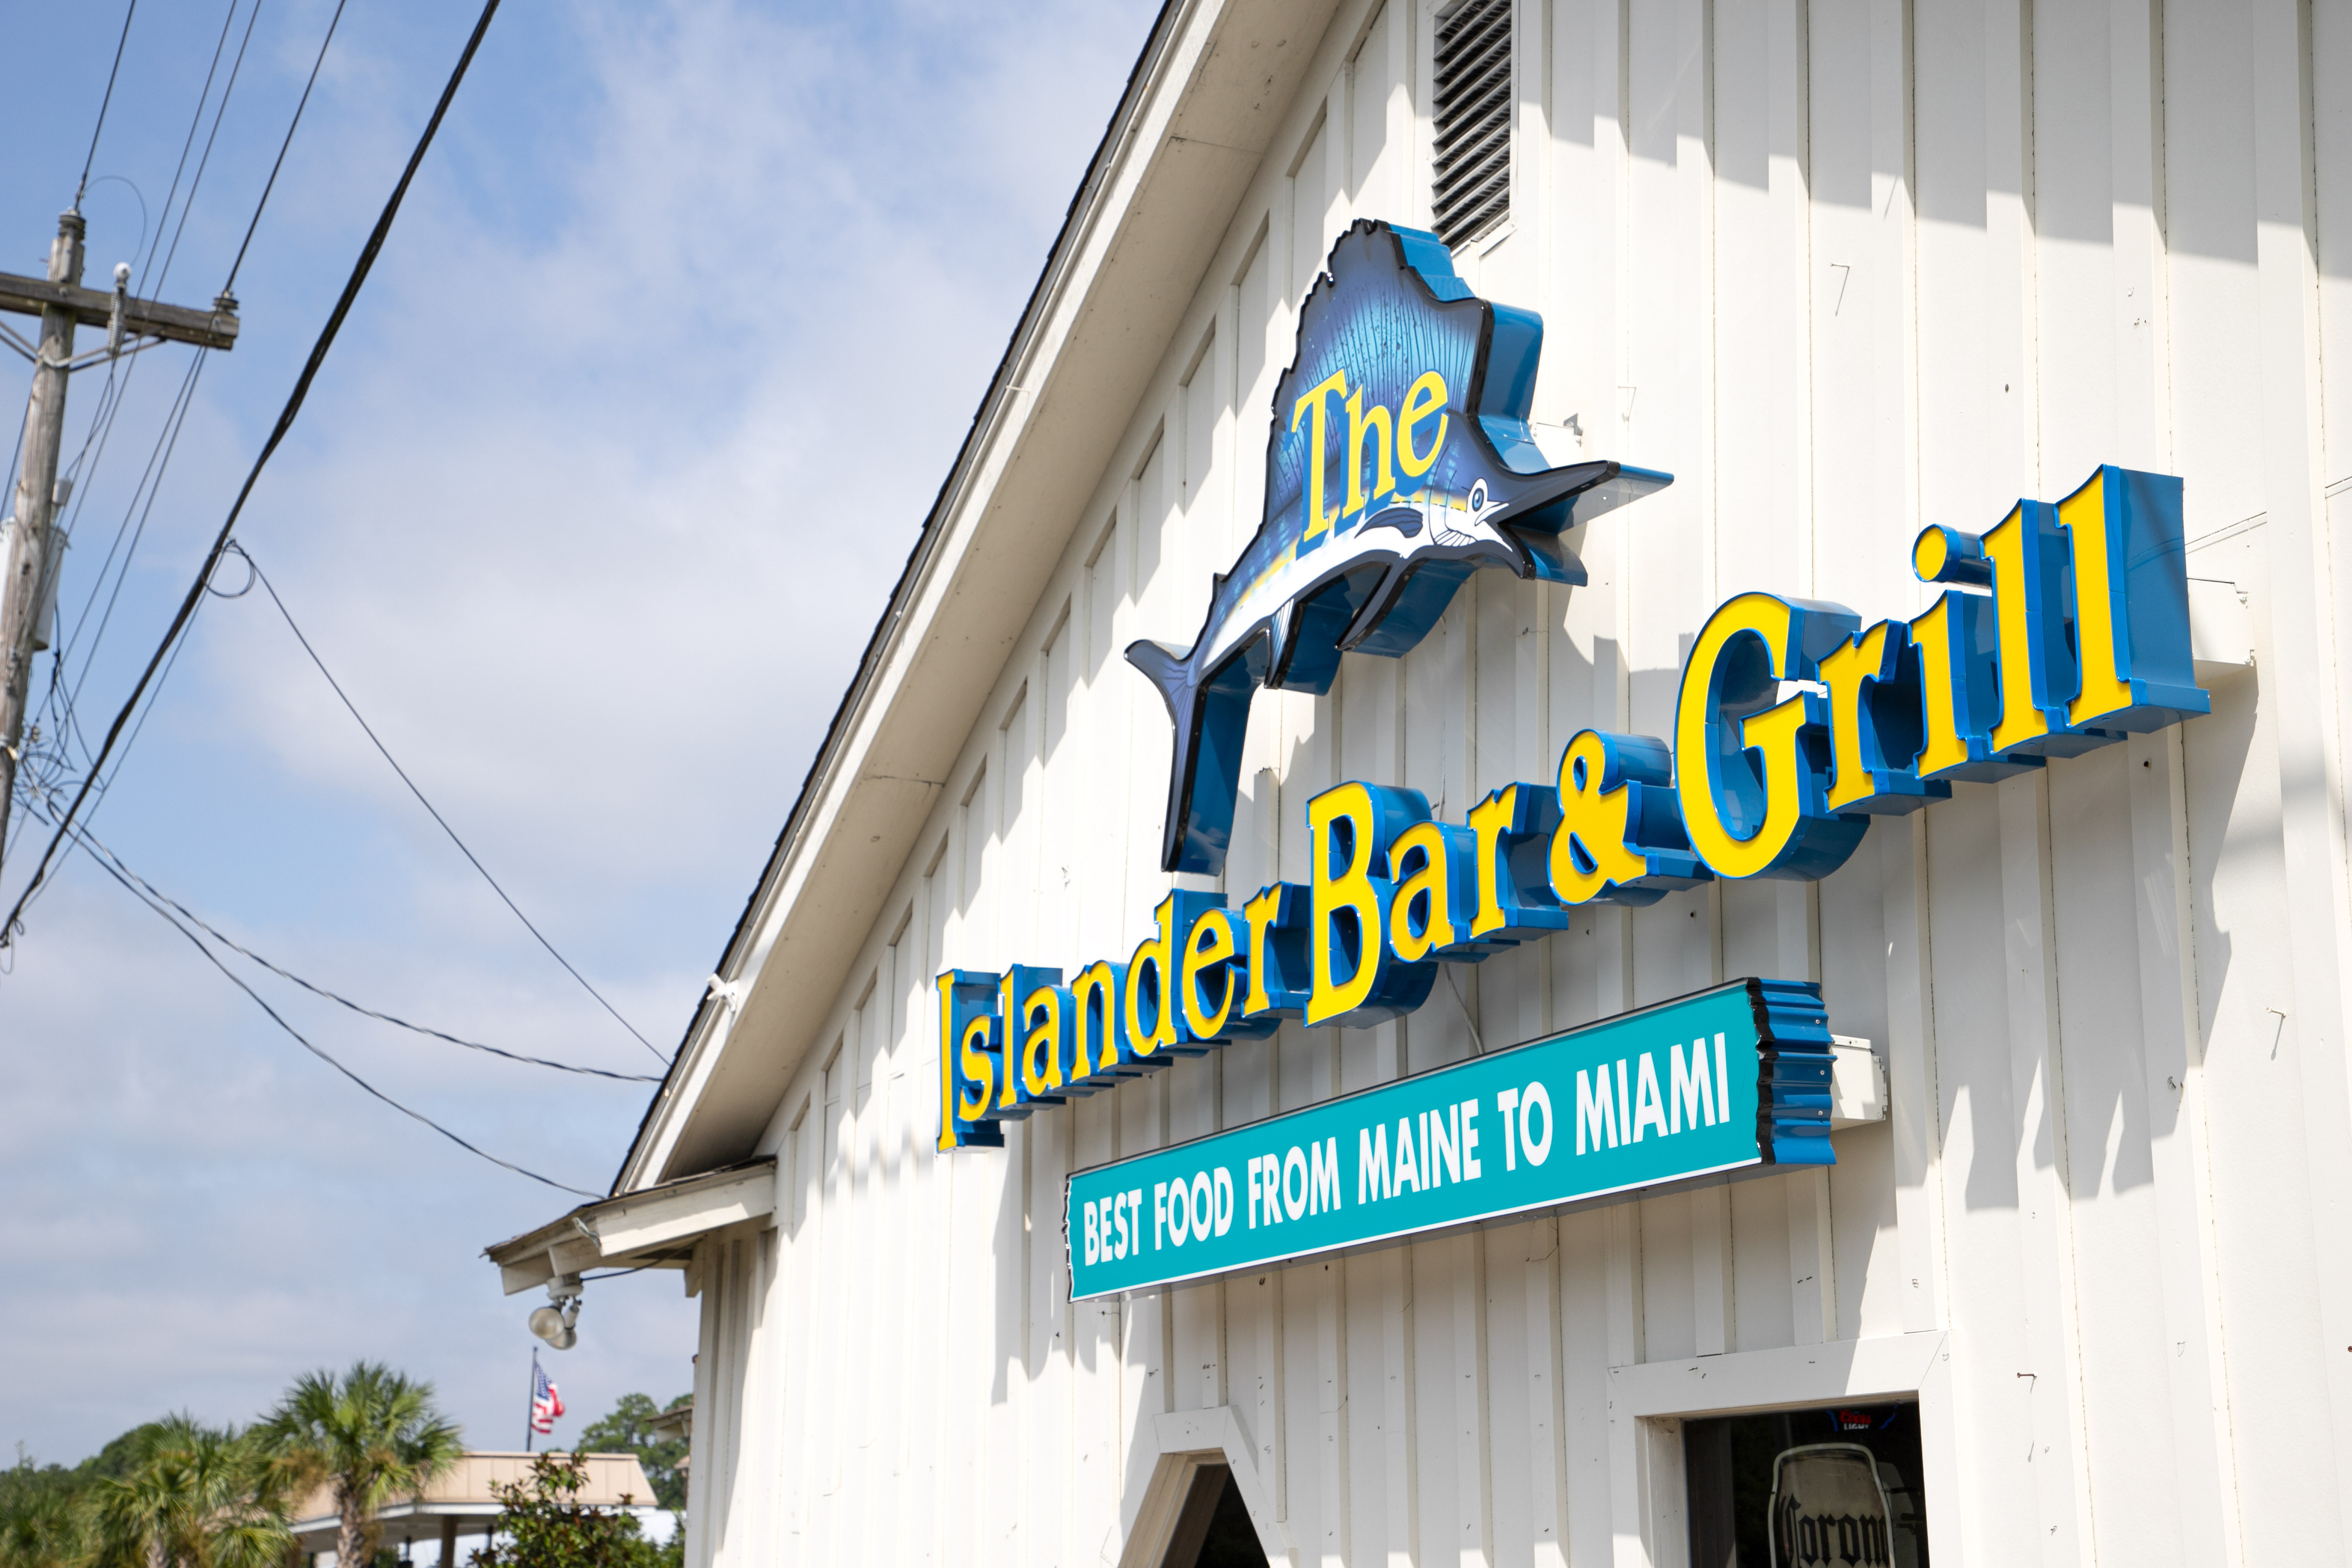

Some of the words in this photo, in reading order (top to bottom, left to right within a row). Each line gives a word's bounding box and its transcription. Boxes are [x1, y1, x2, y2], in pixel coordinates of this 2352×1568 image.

[1290, 368, 1449, 543] The
[936, 884, 1284, 1154] Islander
[1305, 780, 1519, 1027] Bar
[1547, 730, 1648, 905] &
[1675, 472, 2135, 879] Grill
[1083, 1187, 1143, 1267] BEST
[1153, 1165, 1235, 1251] FOOD
[1247, 1136, 1342, 1230] FROM
[1357, 1097, 1482, 1206] MAINE
[1496, 1080, 1554, 1172] TO
[1575, 1031, 1731, 1157] MIAMI
